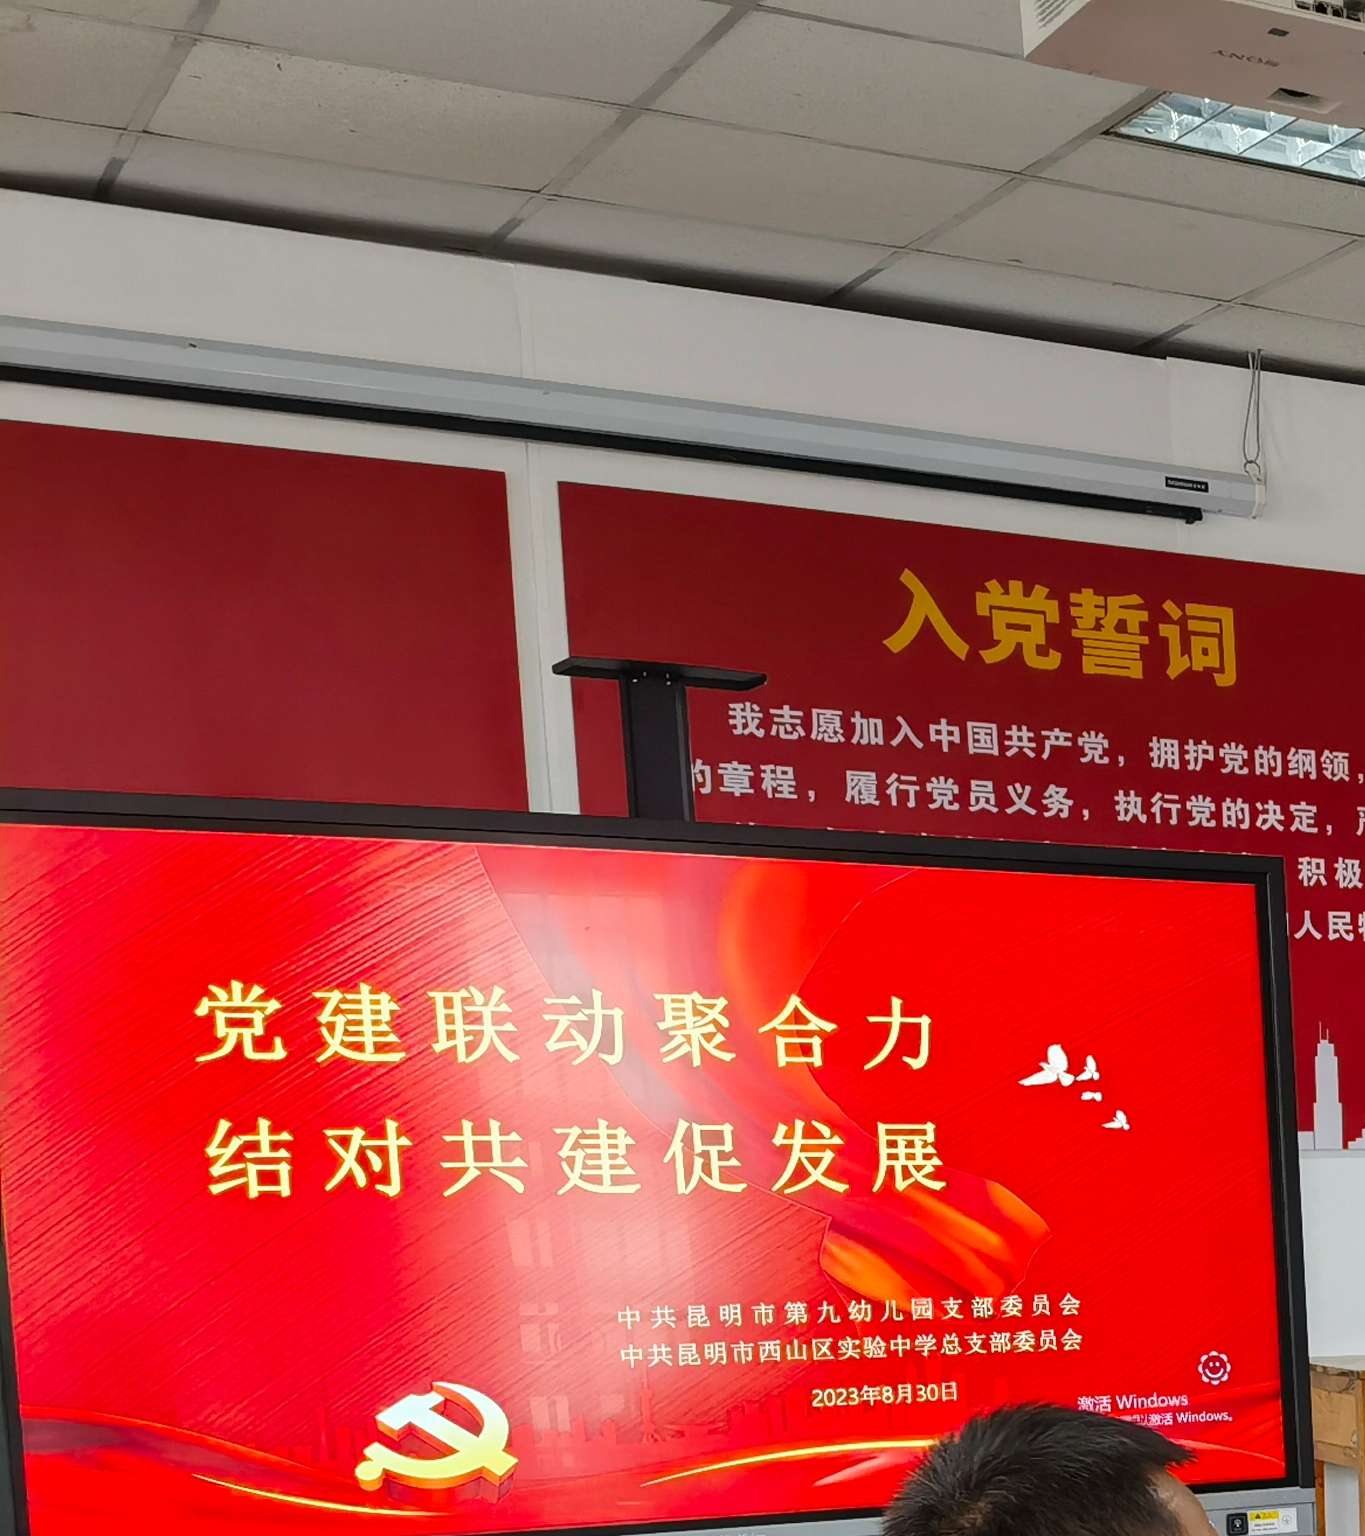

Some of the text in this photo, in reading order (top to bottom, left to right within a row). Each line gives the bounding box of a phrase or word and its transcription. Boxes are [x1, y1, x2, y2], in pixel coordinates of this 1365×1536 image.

[882, 566, 1238, 687] 入党誓词
[194, 978, 933, 1071] 党建联动聚合力
[204, 1116, 948, 1200] 结对共建促发展
[616, 1292, 1083, 1331] 中共昆明市第九幼儿园支部委员会
[620, 1327, 1084, 1369] 中共昆明市西山区实验中学总支部委员会
[811, 1382, 958, 1409] 2023年8月30日
[1077, 1392, 1189, 1413] 激活 Windows
